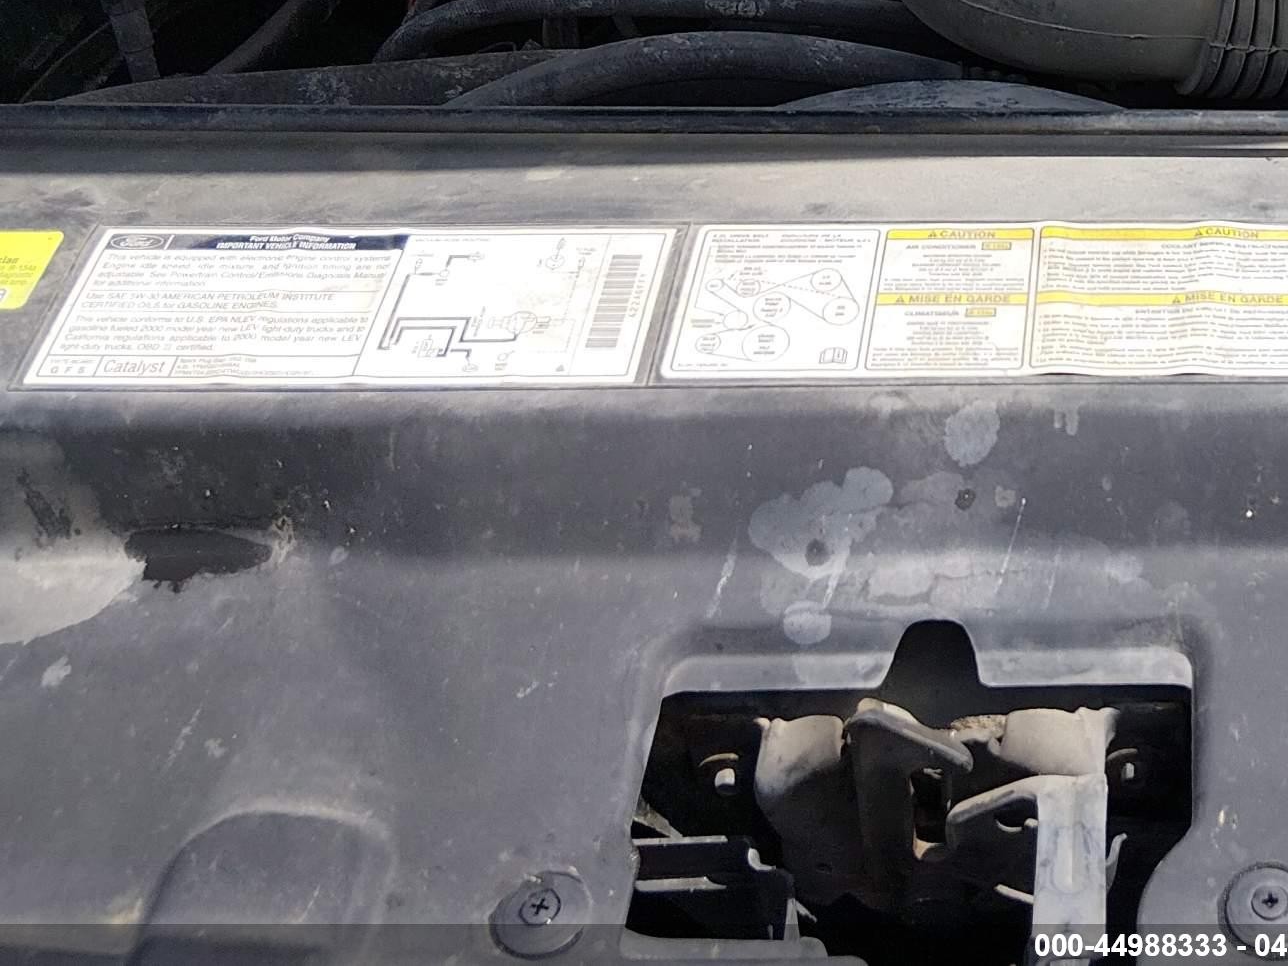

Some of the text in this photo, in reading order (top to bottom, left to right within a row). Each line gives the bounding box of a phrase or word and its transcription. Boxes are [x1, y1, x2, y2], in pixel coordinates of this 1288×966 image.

[939, 230, 996, 238] CAUTION
[1205, 227, 1258, 239] CAUTION
[293, 234, 330, 243] Company
[216, 242, 357, 250] IMPORTANT VEHICLE INFORMATION
[217, 292, 280, 300] PETROLEUM
[908, 293, 1009, 304] MISE EN GARDE
[1184, 292, 1283, 304] MISE EN GARDE
[176, 301, 232, 309] GASOLINE
[311, 316, 358, 324] applicable
[136, 343, 160, 351] OBD
[103, 359, 165, 376] Catalyst
